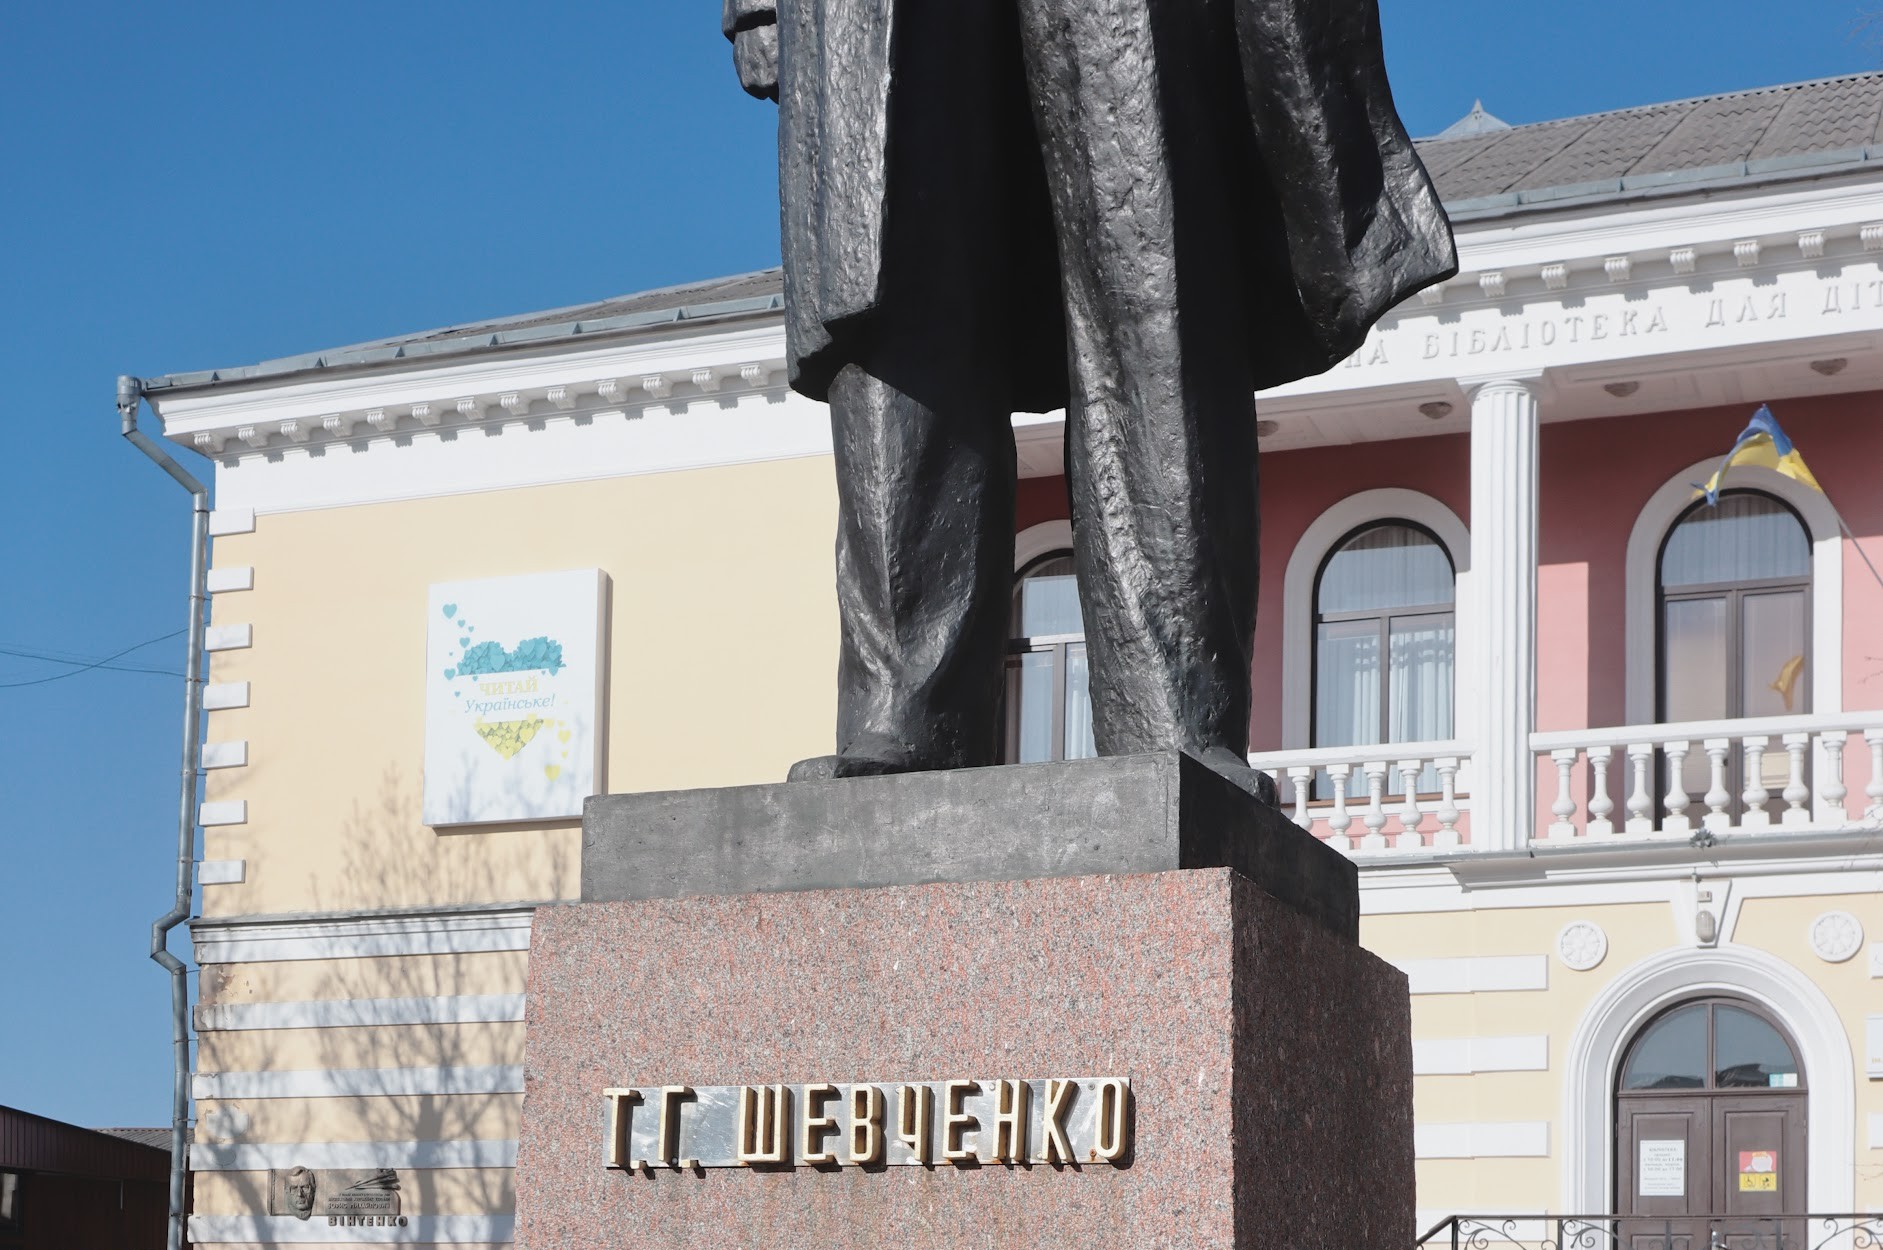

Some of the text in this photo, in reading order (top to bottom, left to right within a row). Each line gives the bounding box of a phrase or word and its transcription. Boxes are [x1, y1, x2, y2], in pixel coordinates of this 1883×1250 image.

[1421, 306, 1669, 360] БІБЛІОТЕКА
[1704, 292, 1787, 329] ДЛЯ
[479, 676, 539, 697] ЧИТАЙ
[464, 692, 556, 715] Українське!
[738, 1077, 1130, 1166] ШЕВЧЕНКО
[328, 1215, 409, 1228] ВІНТЕНКО
